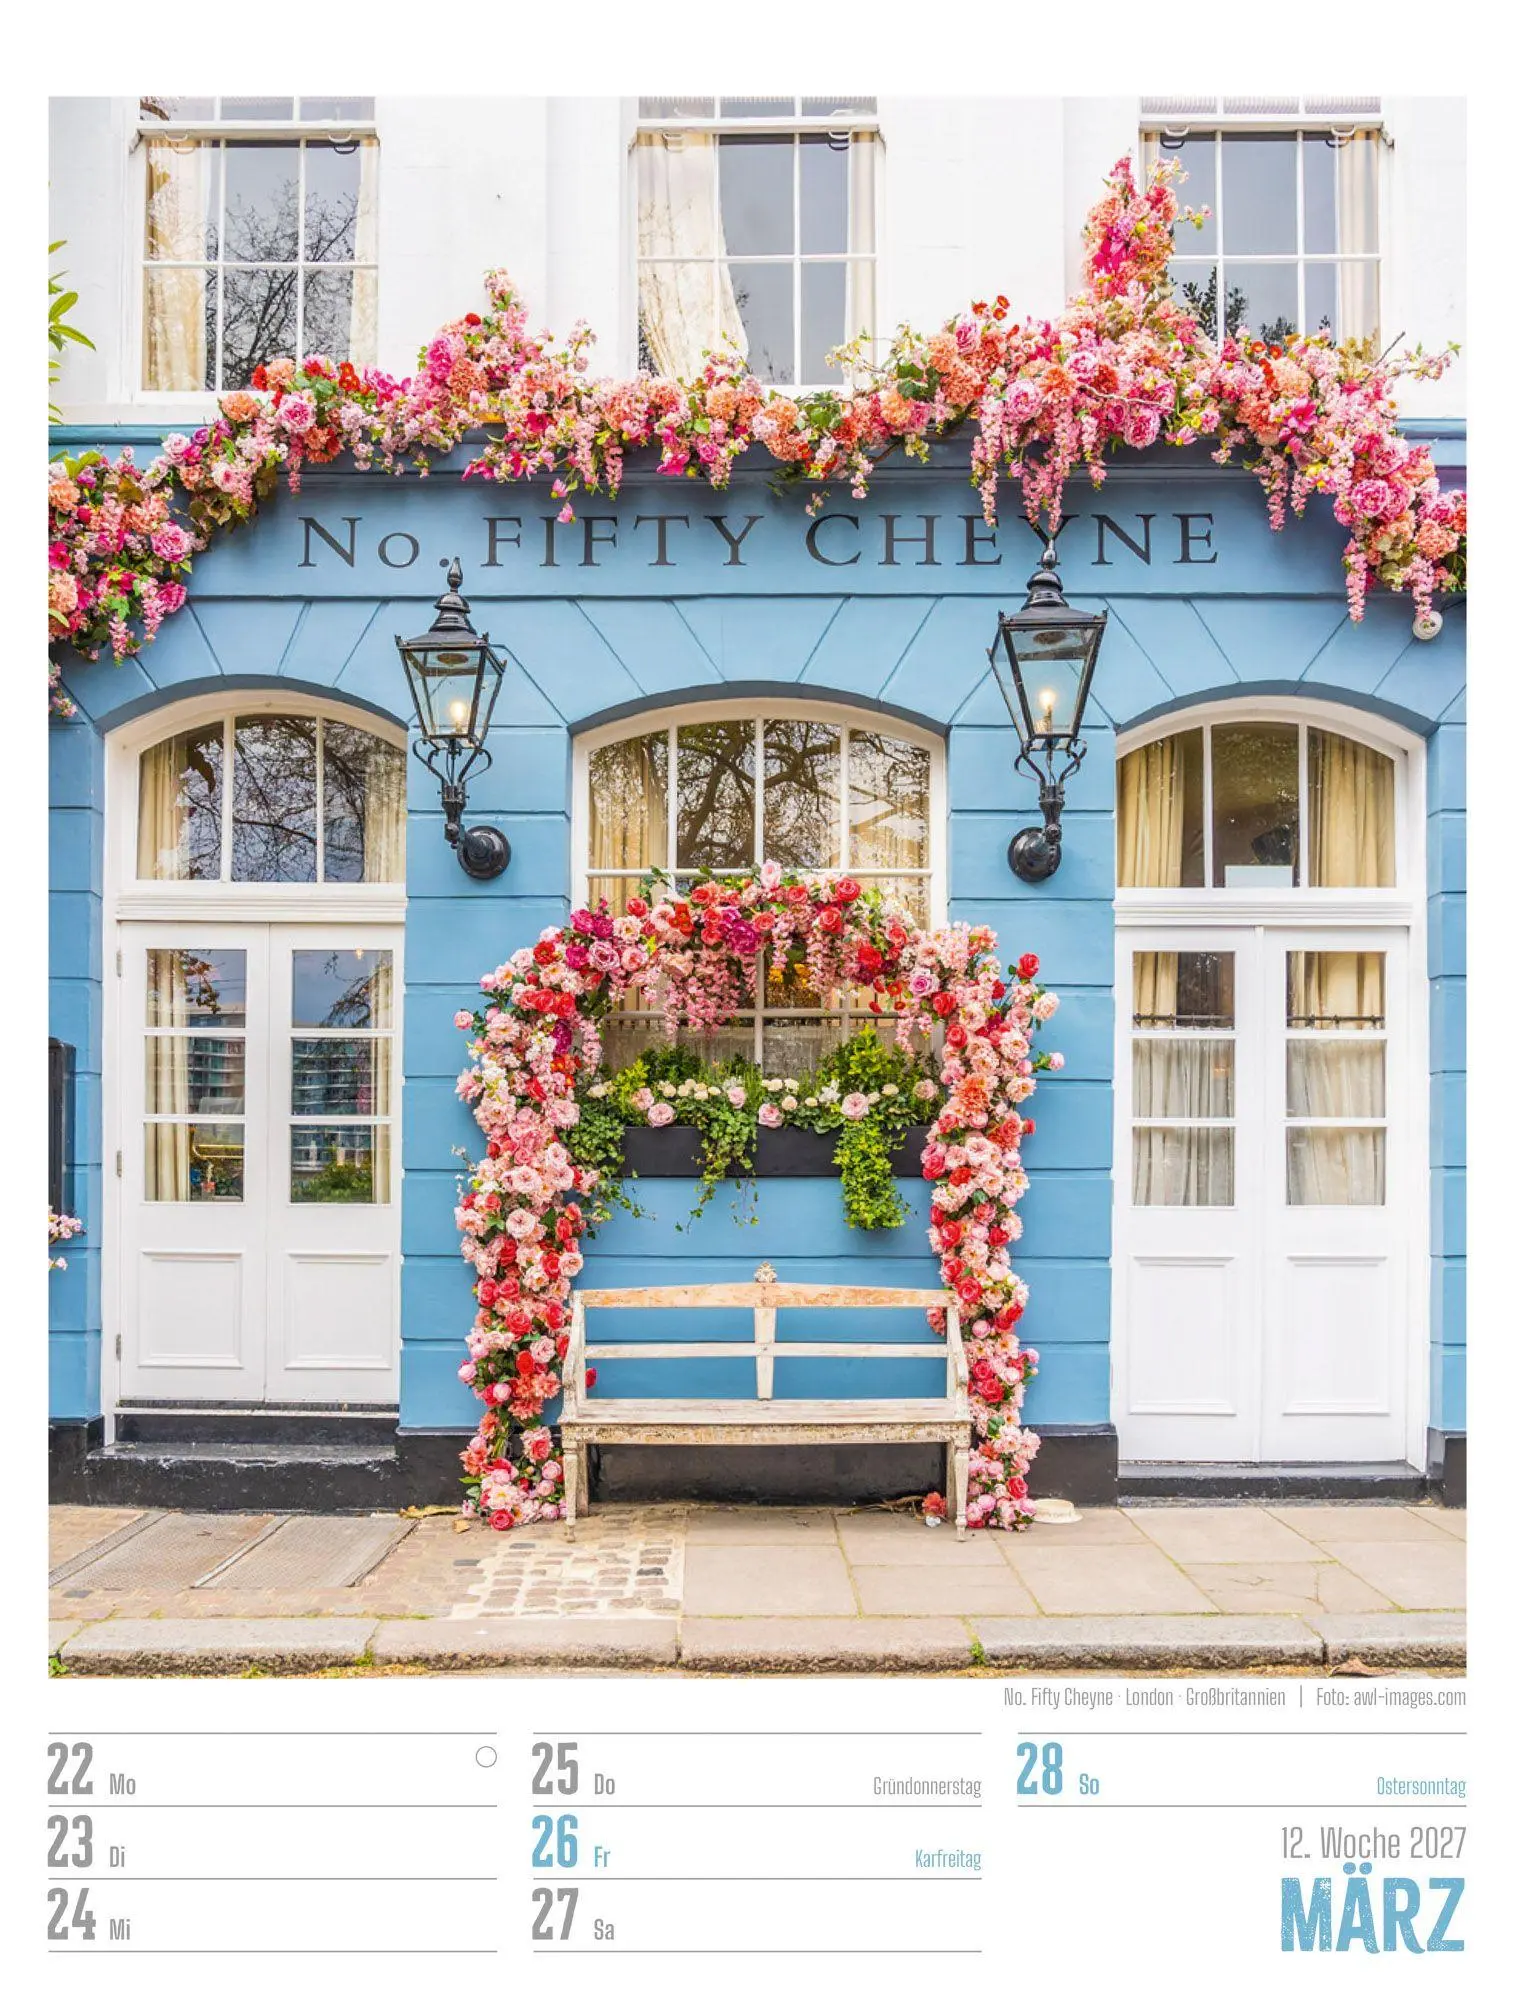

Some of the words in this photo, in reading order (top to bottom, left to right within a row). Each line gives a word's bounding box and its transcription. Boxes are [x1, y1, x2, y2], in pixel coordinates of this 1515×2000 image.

[298, 515, 452, 568] No.
[480, 514, 765, 567] FIFTY
[805, 513, 1219, 566] CHEYNE
